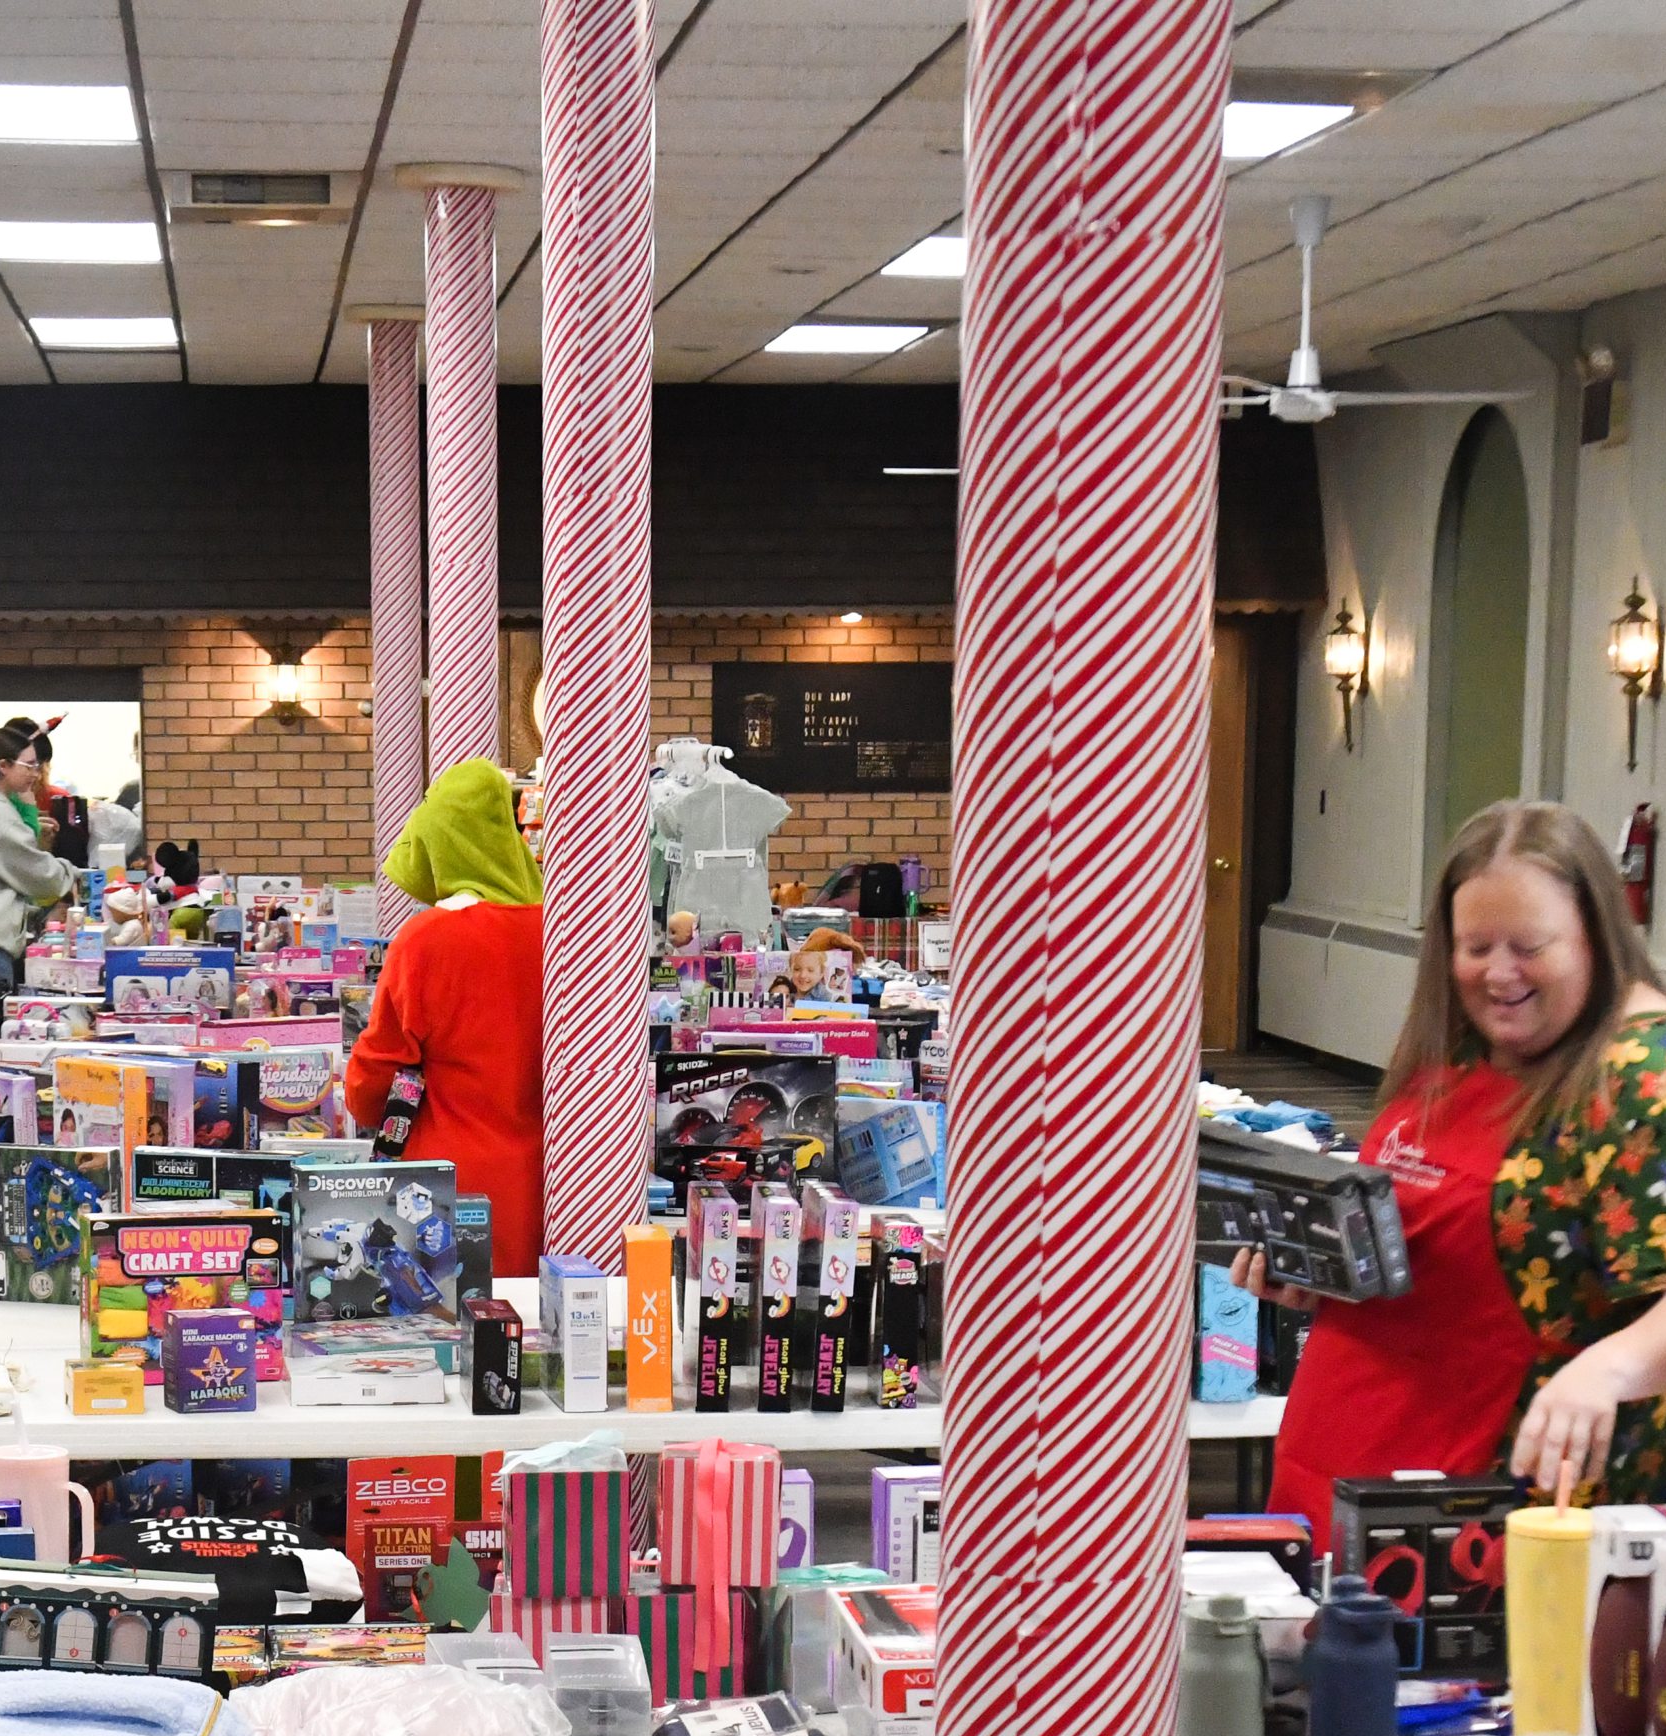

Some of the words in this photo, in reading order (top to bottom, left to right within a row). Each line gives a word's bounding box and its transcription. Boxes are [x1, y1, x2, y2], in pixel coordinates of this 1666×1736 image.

[830, 692, 852, 701] LADY
[822, 716, 859, 725] CARMEL
[804, 728, 850, 737] SCHOOL
[828, 1031, 849, 1039] Paper
[260, 1065, 330, 1086] riendship
[670, 1068, 750, 1103] RACER
[157, 1165, 195, 1175] SCIENCE
[139, 1186, 212, 1198] LABORATORY
[140, 1178, 211, 1189] BIOLUMINESCENT
[308, 1175, 395, 1192] Discovery
[128, 1252, 193, 1272] CRAFT
[201, 1251, 240, 1270] SET
[633, 1290, 658, 1364] VEX
[659, 1289, 667, 1365] ROBOTICS
[182, 1334, 215, 1342] KARAOKE
[215, 1333, 246, 1341] MACHINE
[508, 1341, 518, 1379] SPEED
[701, 1335, 717, 1397] JEWELRY
[763, 1335, 779, 1397] JEWELRY
[818, 1334, 834, 1396] JEWELRY
[717, 1367, 728, 1395] glow
[779, 1367, 790, 1395] glow
[833, 1367, 844, 1395] glow
[190, 1385, 245, 1400] KARAOKE
[355, 1477, 447, 1496] ZEBCO
[137, 1526, 300, 1544] UPSIDE
[372, 1527, 432, 1545] TITAN
[180, 1541, 259, 1553] STRANGER
[195, 1549, 247, 1557] THINGS
[374, 1545, 432, 1554] COLLECTION
[378, 1558, 409, 1566] SERIES
[410, 1558, 428, 1566] ONE
